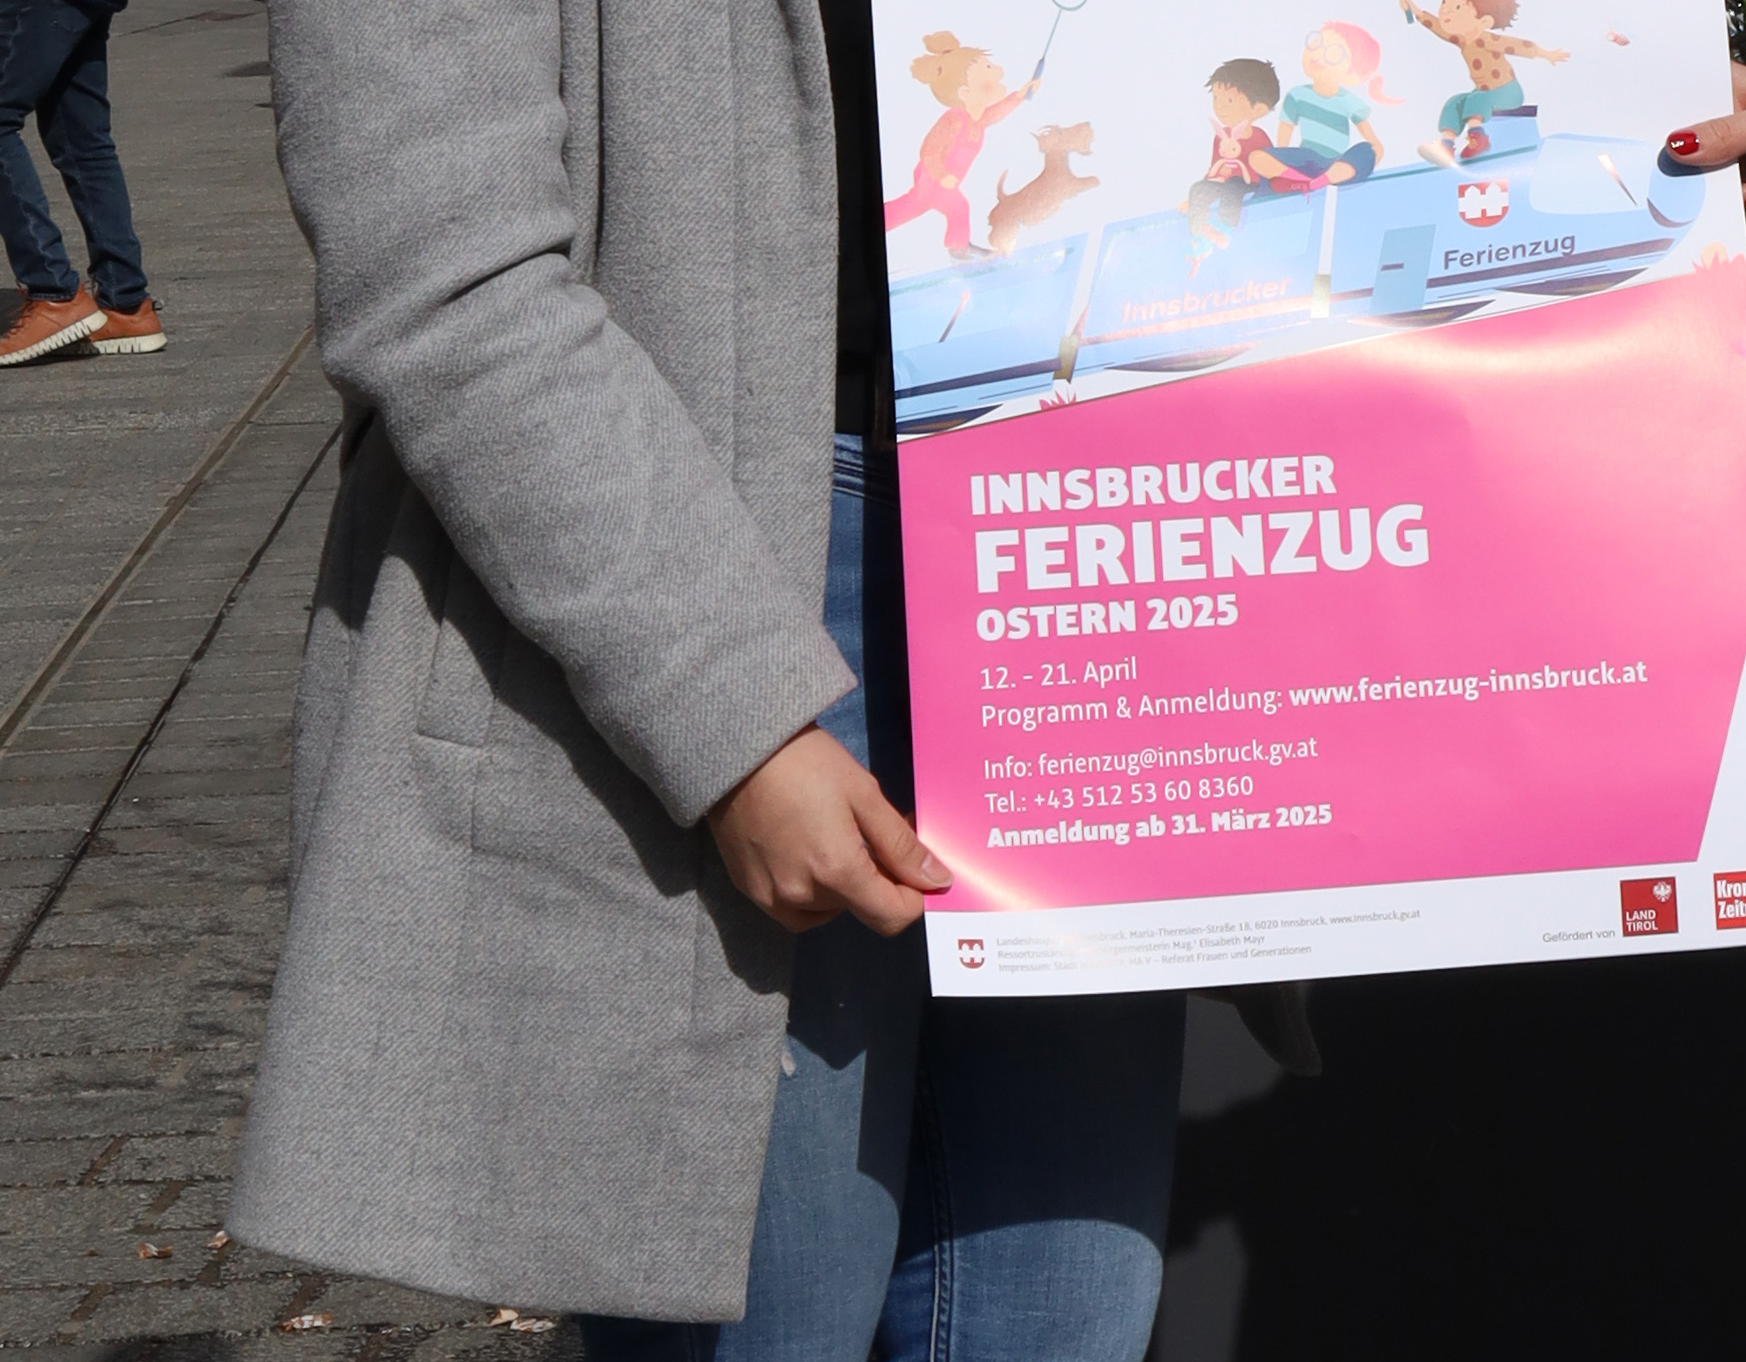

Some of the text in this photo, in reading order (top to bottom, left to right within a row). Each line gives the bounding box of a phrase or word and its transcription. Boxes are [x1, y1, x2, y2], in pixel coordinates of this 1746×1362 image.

[1443, 233, 1577, 271] Ferienzug
[1120, 277, 1292, 325] Innsbrucker
[969, 455, 1337, 515] INNSBRUCKER
[974, 504, 1430, 594] FERIENZUG
[976, 593, 1239, 642] OSTERN 2025
[980, 666, 1016, 690] 12.
[1040, 663, 1077, 687] 21.
[1083, 656, 1138, 688] April
[982, 660, 1649, 732] Programm & Anmeldung: www.ferienzug-innsbruck.at
[984, 736, 1319, 780] Info: ferienzug@innsbruck.gv.at
[985, 775, 1254, 815] Tel.: +43 512 53 60 8360
[987, 803, 1333, 850] Anmeldung ab 31. März 2025
[1255, 919, 1279, 931] 6020
[1625, 909, 1657, 922] LAND
[1626, 920, 1659, 932] TIROL
[1161, 952, 1195, 965] Referat
[1197, 950, 1228, 962] Frauen
[1230, 948, 1249, 959] und
[1250, 944, 1313, 958] Generationen
[1199, 935, 1241, 948] Elisabeth
[1244, 934, 1265, 947] Mayr
[1542, 928, 1616, 943] Gefördert von
